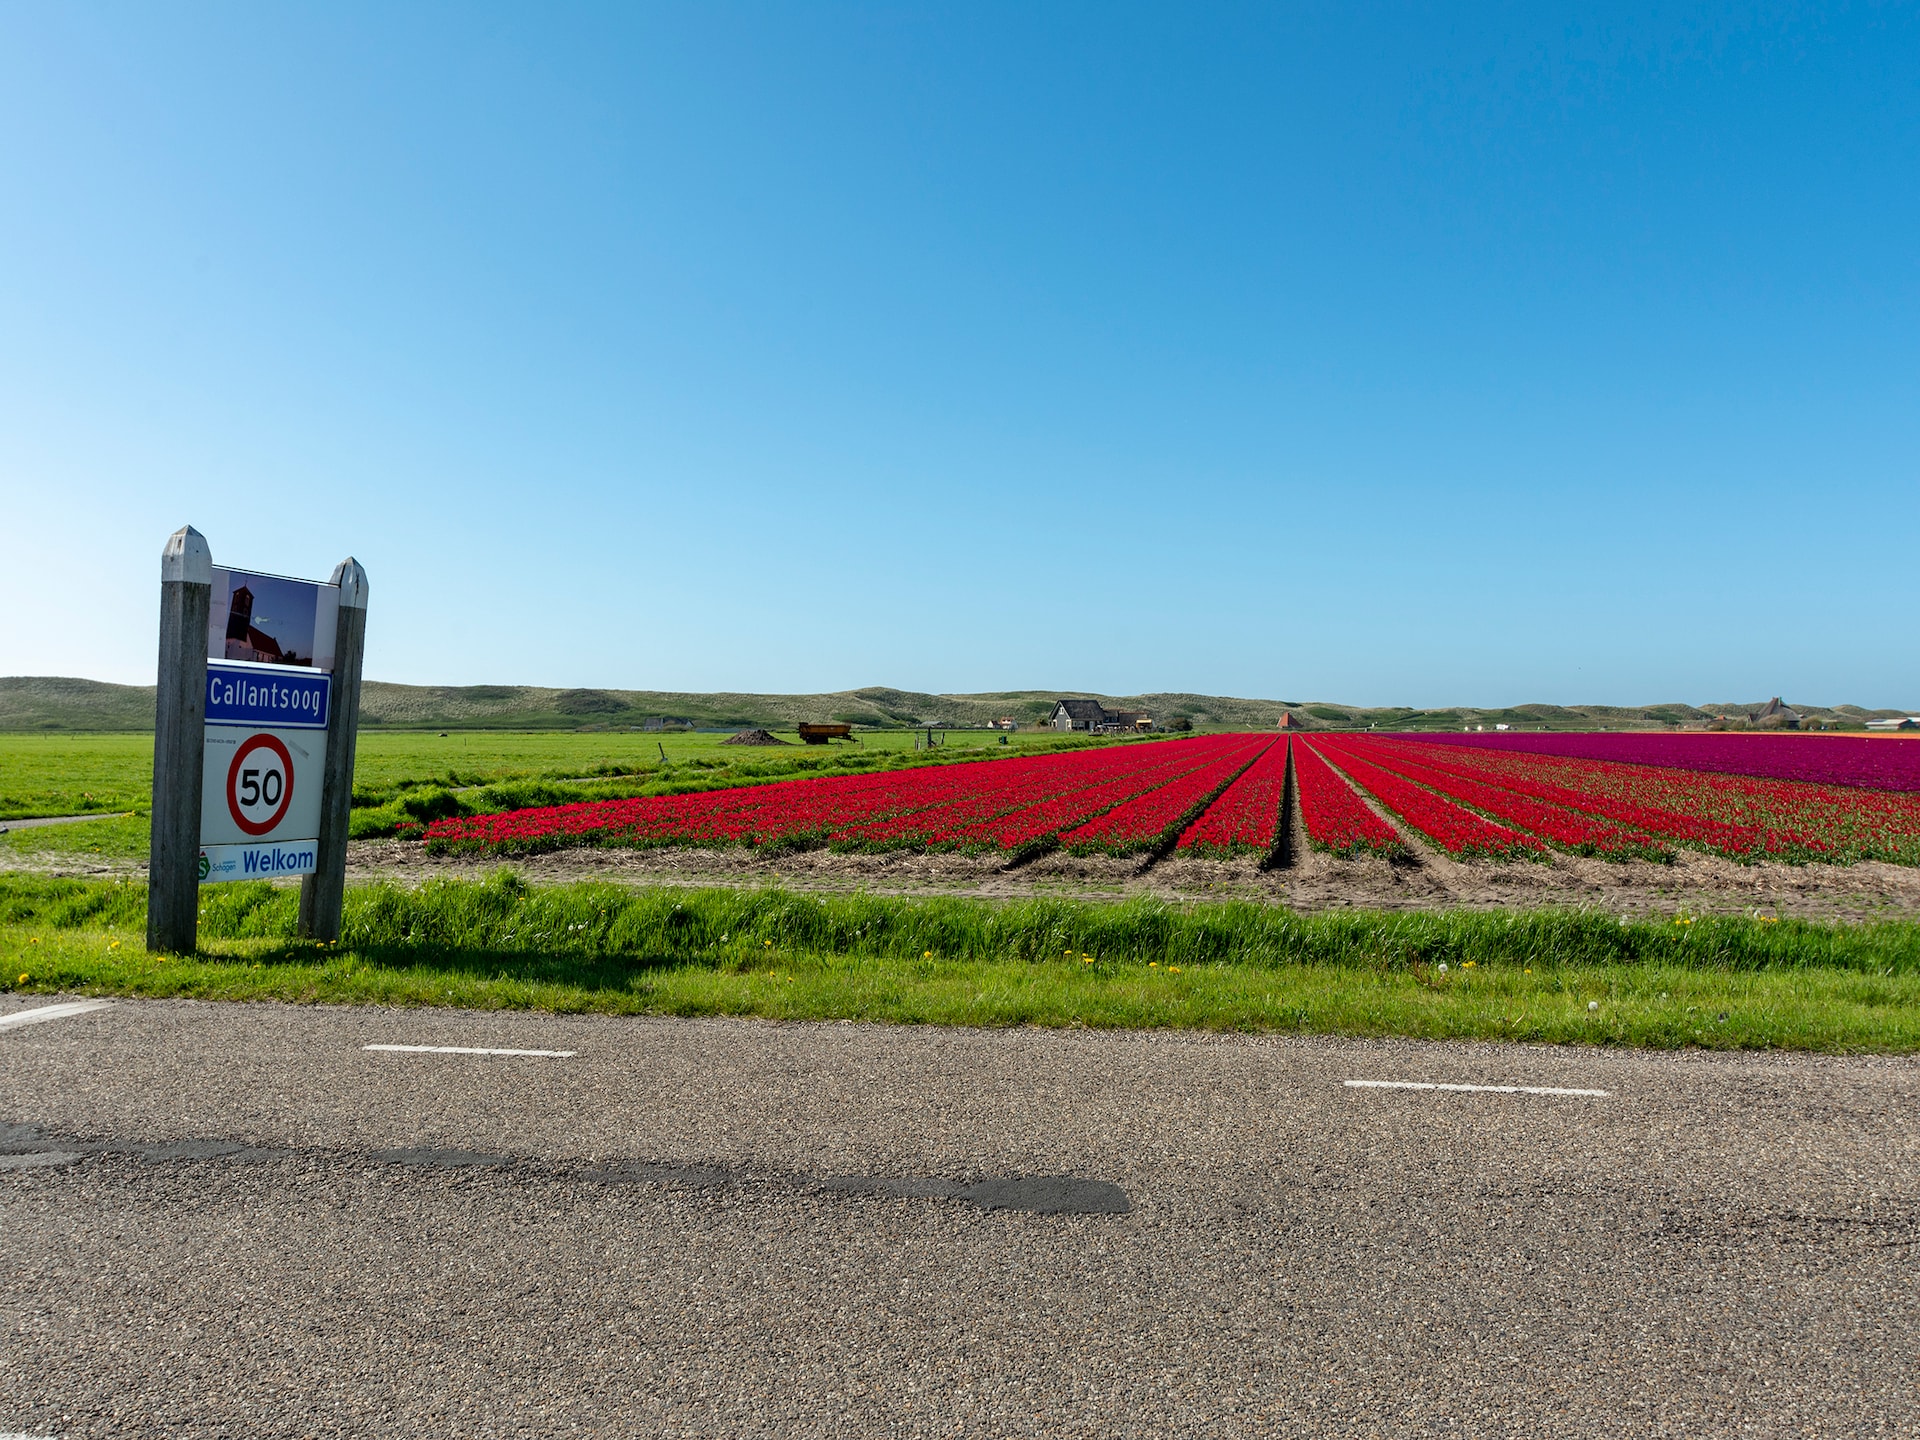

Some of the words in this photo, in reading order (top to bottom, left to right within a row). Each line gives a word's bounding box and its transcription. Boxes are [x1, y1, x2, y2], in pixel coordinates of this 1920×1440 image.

[210, 677, 320, 717] Callantsoog
[240, 769, 282, 806] 50
[212, 862, 236, 873] Schagen
[243, 848, 313, 873] Welkom
